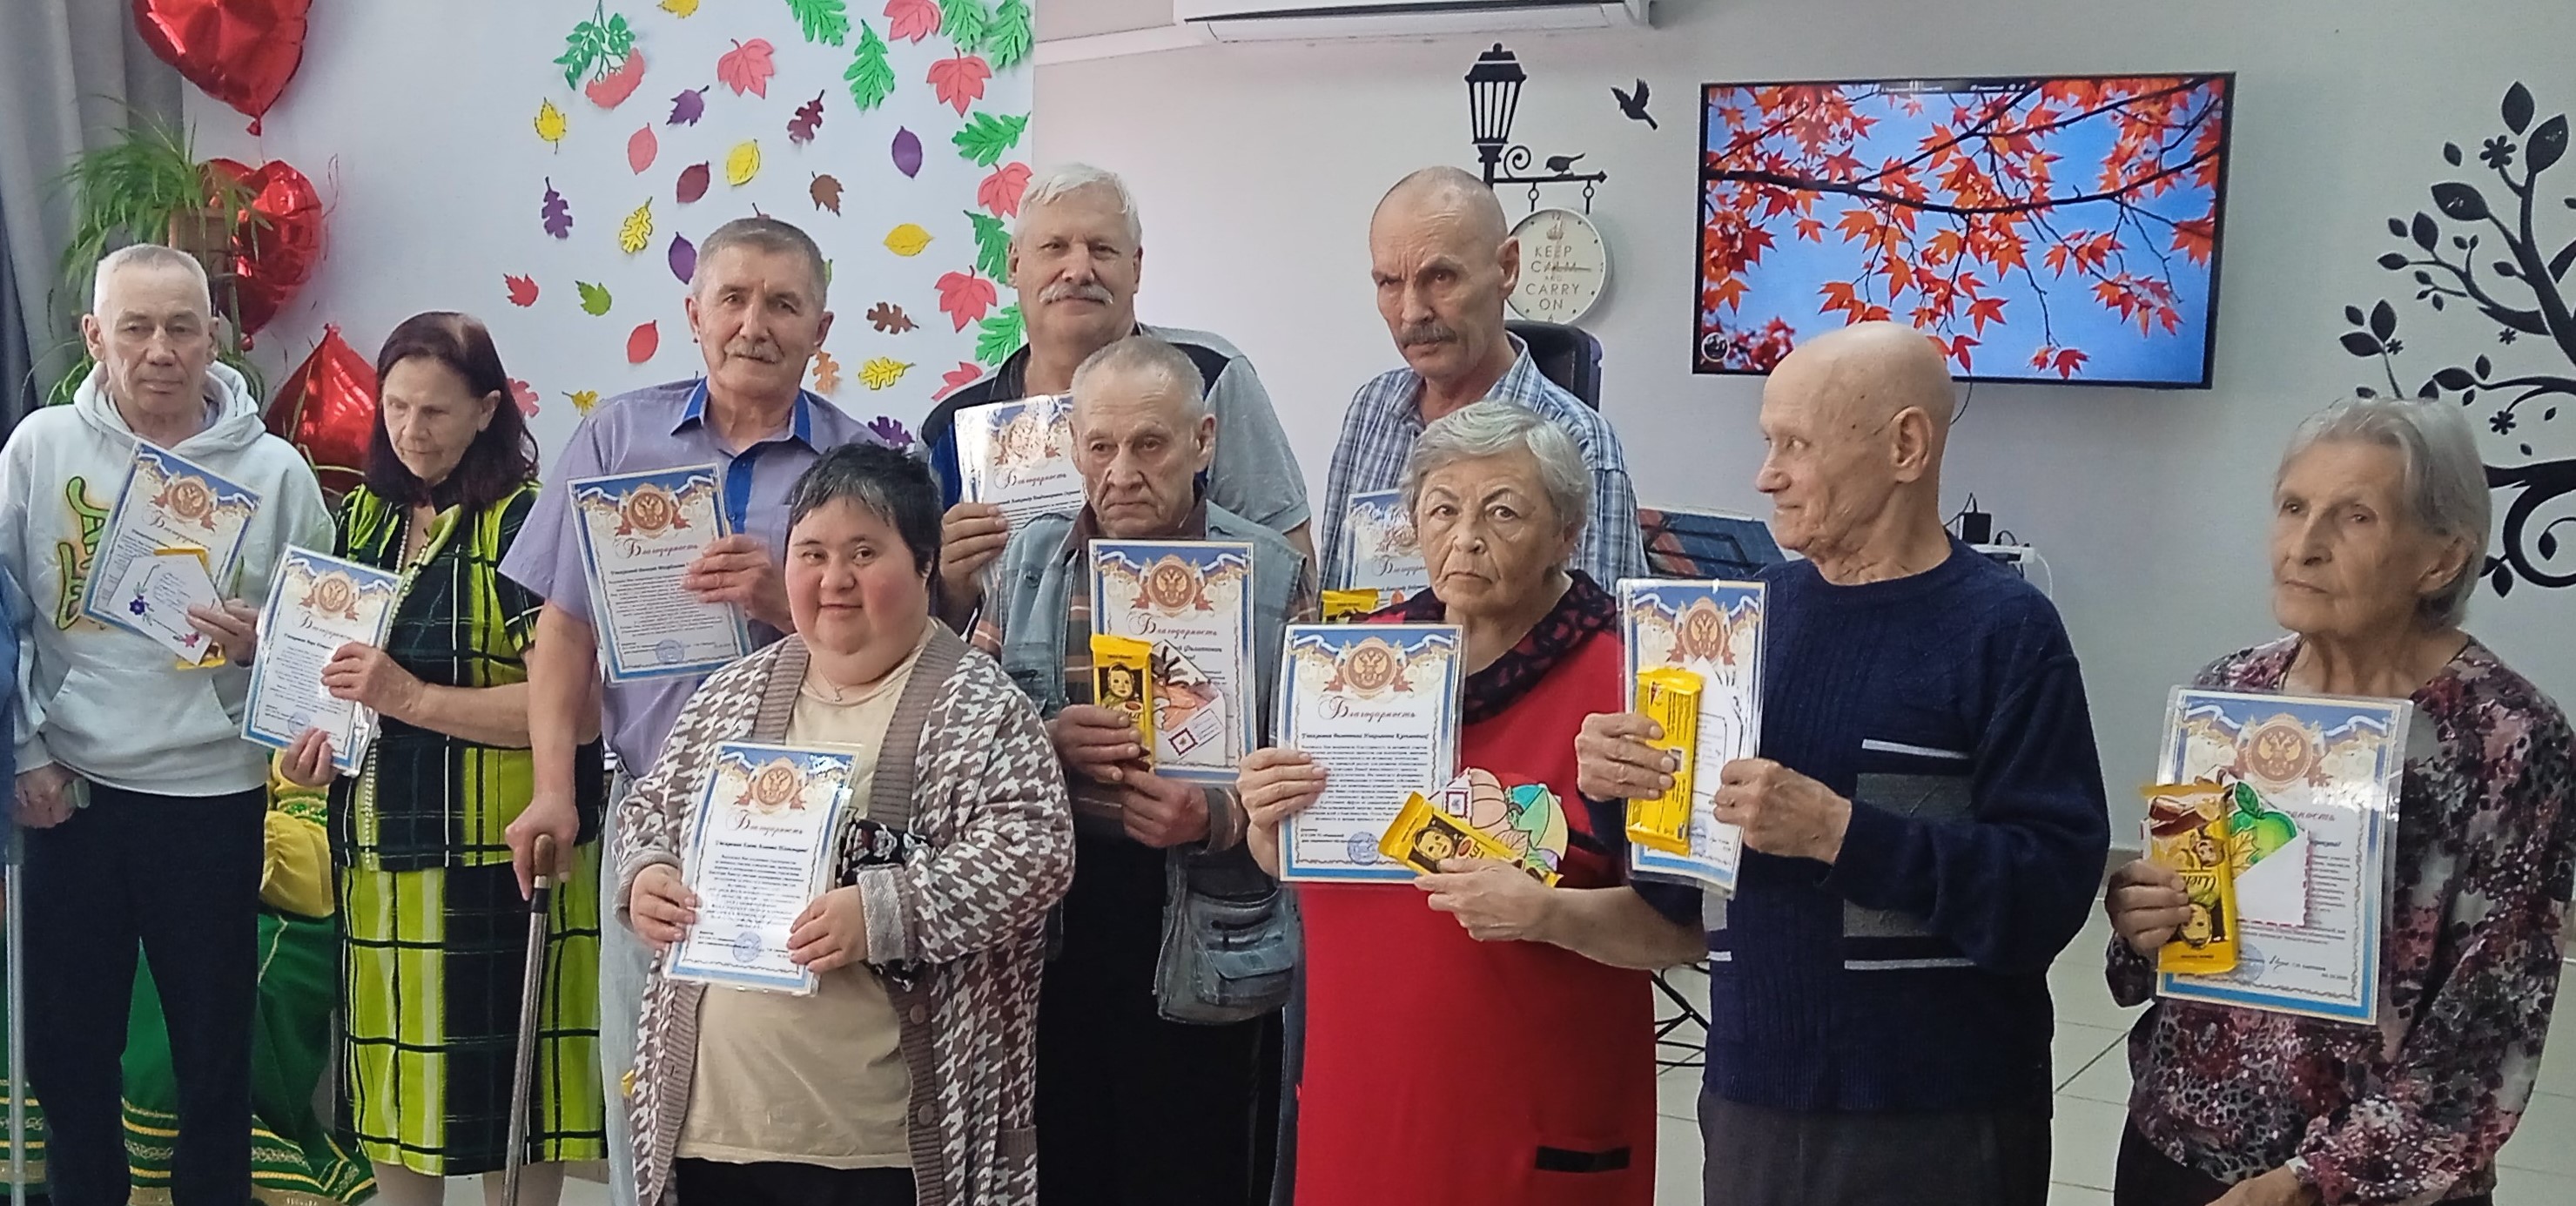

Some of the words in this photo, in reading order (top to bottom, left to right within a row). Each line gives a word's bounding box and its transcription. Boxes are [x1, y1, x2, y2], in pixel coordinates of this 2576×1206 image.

[1535, 246, 1572, 258] KEEP
[1530, 260, 1577, 273] CALM
[1525, 283, 1580, 295] CARRY
[1539, 298, 1564, 310] ON
[1127, 610, 1218, 639] Благодарность
[1318, 696, 1417, 723] Благодарность
